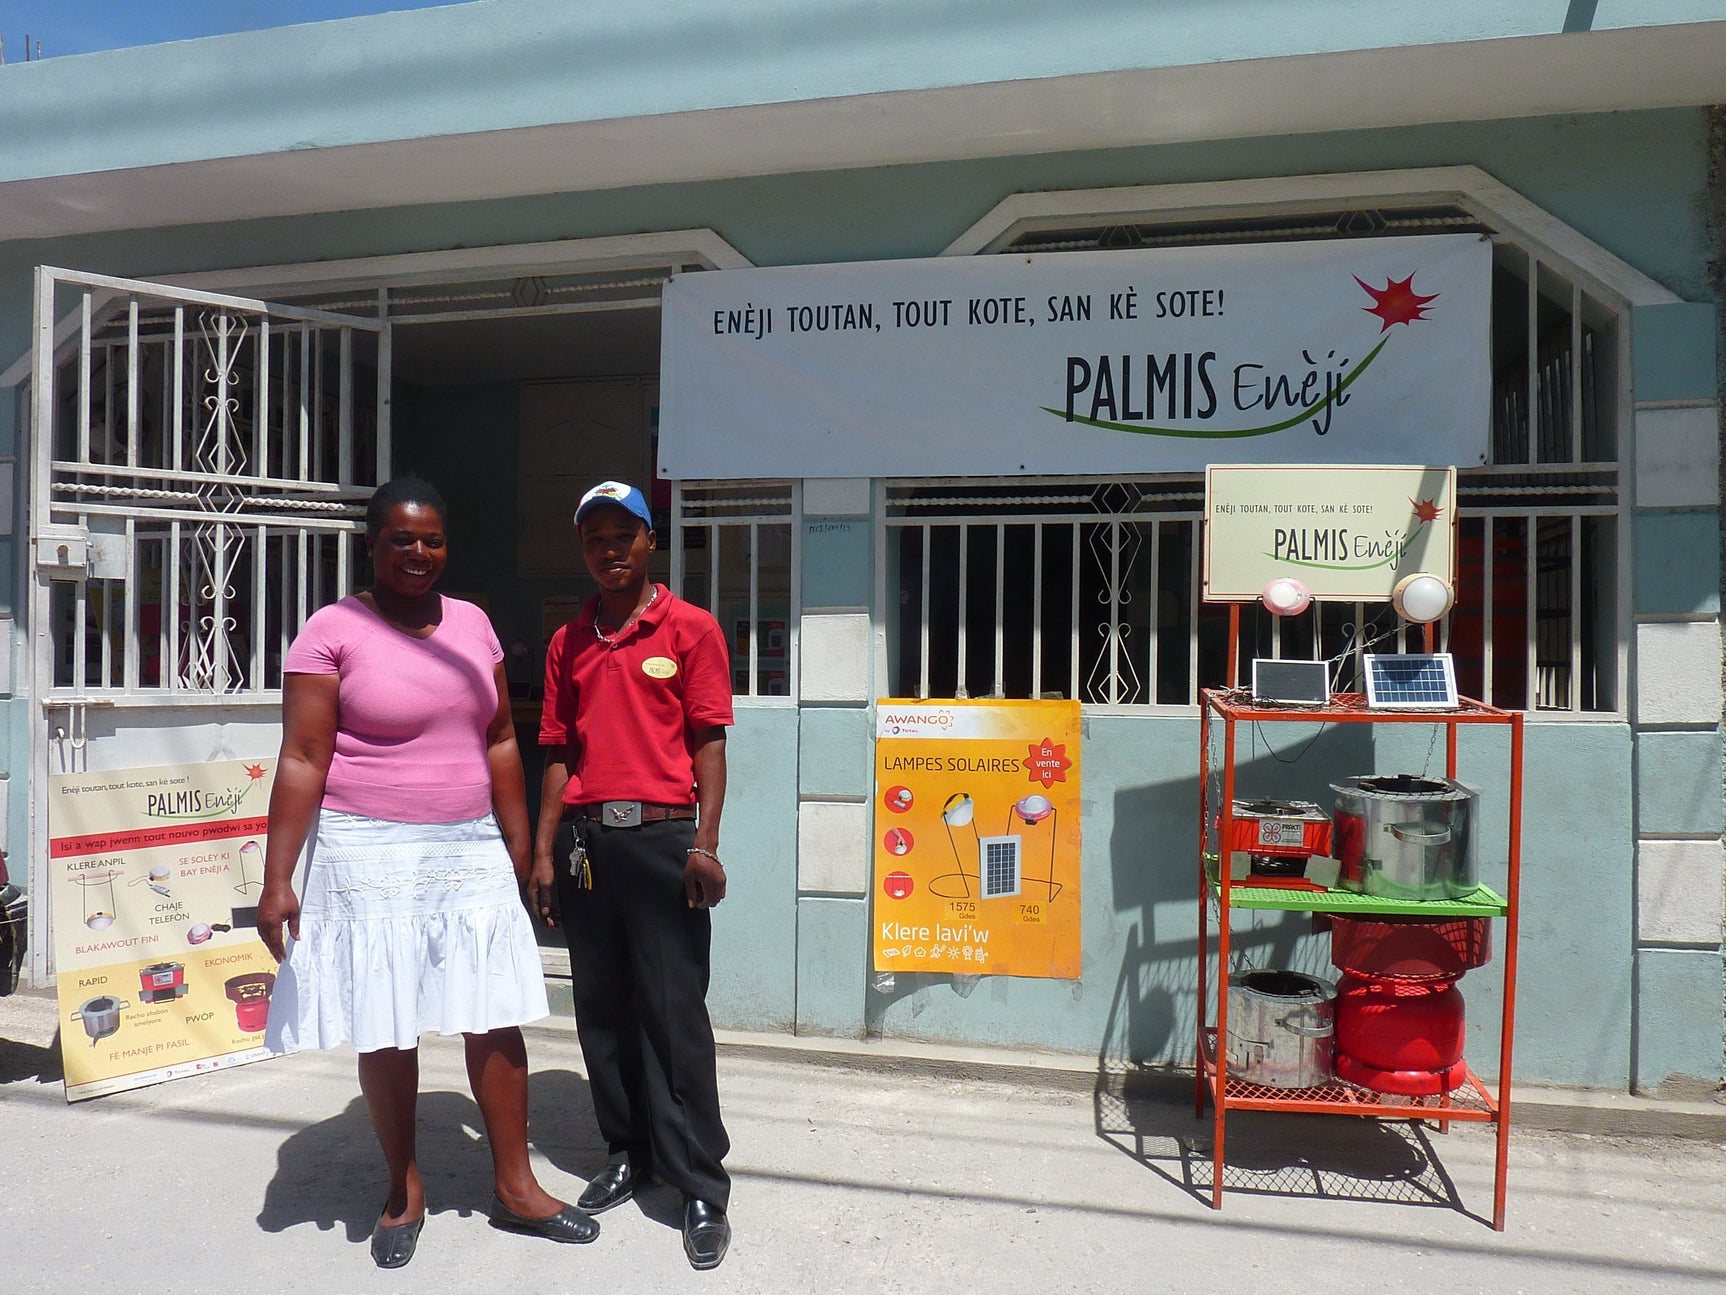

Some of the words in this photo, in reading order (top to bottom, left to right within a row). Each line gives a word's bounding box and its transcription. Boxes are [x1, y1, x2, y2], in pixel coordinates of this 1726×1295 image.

[714, 303, 772, 340] ENÈJI
[787, 304, 882, 333] TOUTAN,
[893, 300, 952, 328] TOUT
[968, 297, 1036, 327] KOTE,
[1047, 294, 1092, 322] SAN
[1110, 286, 1138, 320] KÈ
[1156, 289, 1225, 318] SOTE!
[1066, 351, 1217, 422] PALMIS
[1233, 349, 1352, 436] Enèji
[1215, 502, 1236, 516] ENÈJI
[1240, 504, 1271, 514] TOUTAN,
[1274, 504, 1292, 514] TOUT
[1296, 504, 1318, 514] KOTE,
[1320, 504, 1335, 514] SAN
[1339, 502, 1349, 514] KÈ
[1352, 504, 1373, 514] SOTE!
[1274, 528, 1348, 561] PALMIS
[1354, 530, 1407, 571] Enèji
[885, 714, 949, 725] AWANGO
[1041, 748, 1052, 756] En
[884, 756, 943, 772] LAMPES
[948, 758, 1020, 773] SOLAIRES
[1036, 760, 1060, 768] vente
[1042, 770, 1052, 779] ici
[82, 784, 108, 792] toutan,
[126, 781, 145, 789] kote,
[148, 790, 202, 816] PALMIS
[205, 787, 242, 815] Enèji
[61, 842, 72, 851] Isi
[86, 840, 107, 849] wap
[110, 836, 141, 848] jwenn
[144, 832, 166, 842] tout
[168, 830, 200, 840] nouvo
[202, 822, 241, 838] pwodwi
[256, 822, 268, 832] yo
[66, 860, 97, 872] KLERE
[98, 857, 126, 868] ANPIL
[179, 857, 189, 866] SE
[221, 852, 230, 860] KI
[180, 868, 198, 877] BAY
[154, 901, 184, 913] CHAJE
[950, 902, 976, 912] 1575
[1020, 904, 1040, 914] 740
[882, 922, 930, 941] Klere
[936, 922, 990, 944] lavi'w
[75, 938, 138, 954] BLAKAWOUT
[141, 934, 160, 945] FINI
[204, 952, 254, 968] EKONOMIK
[78, 976, 108, 988] RAPID
[122, 1045, 154, 1058] MANJE
[156, 1044, 164, 1052] PI
[166, 1039, 190, 1050] FASIL
